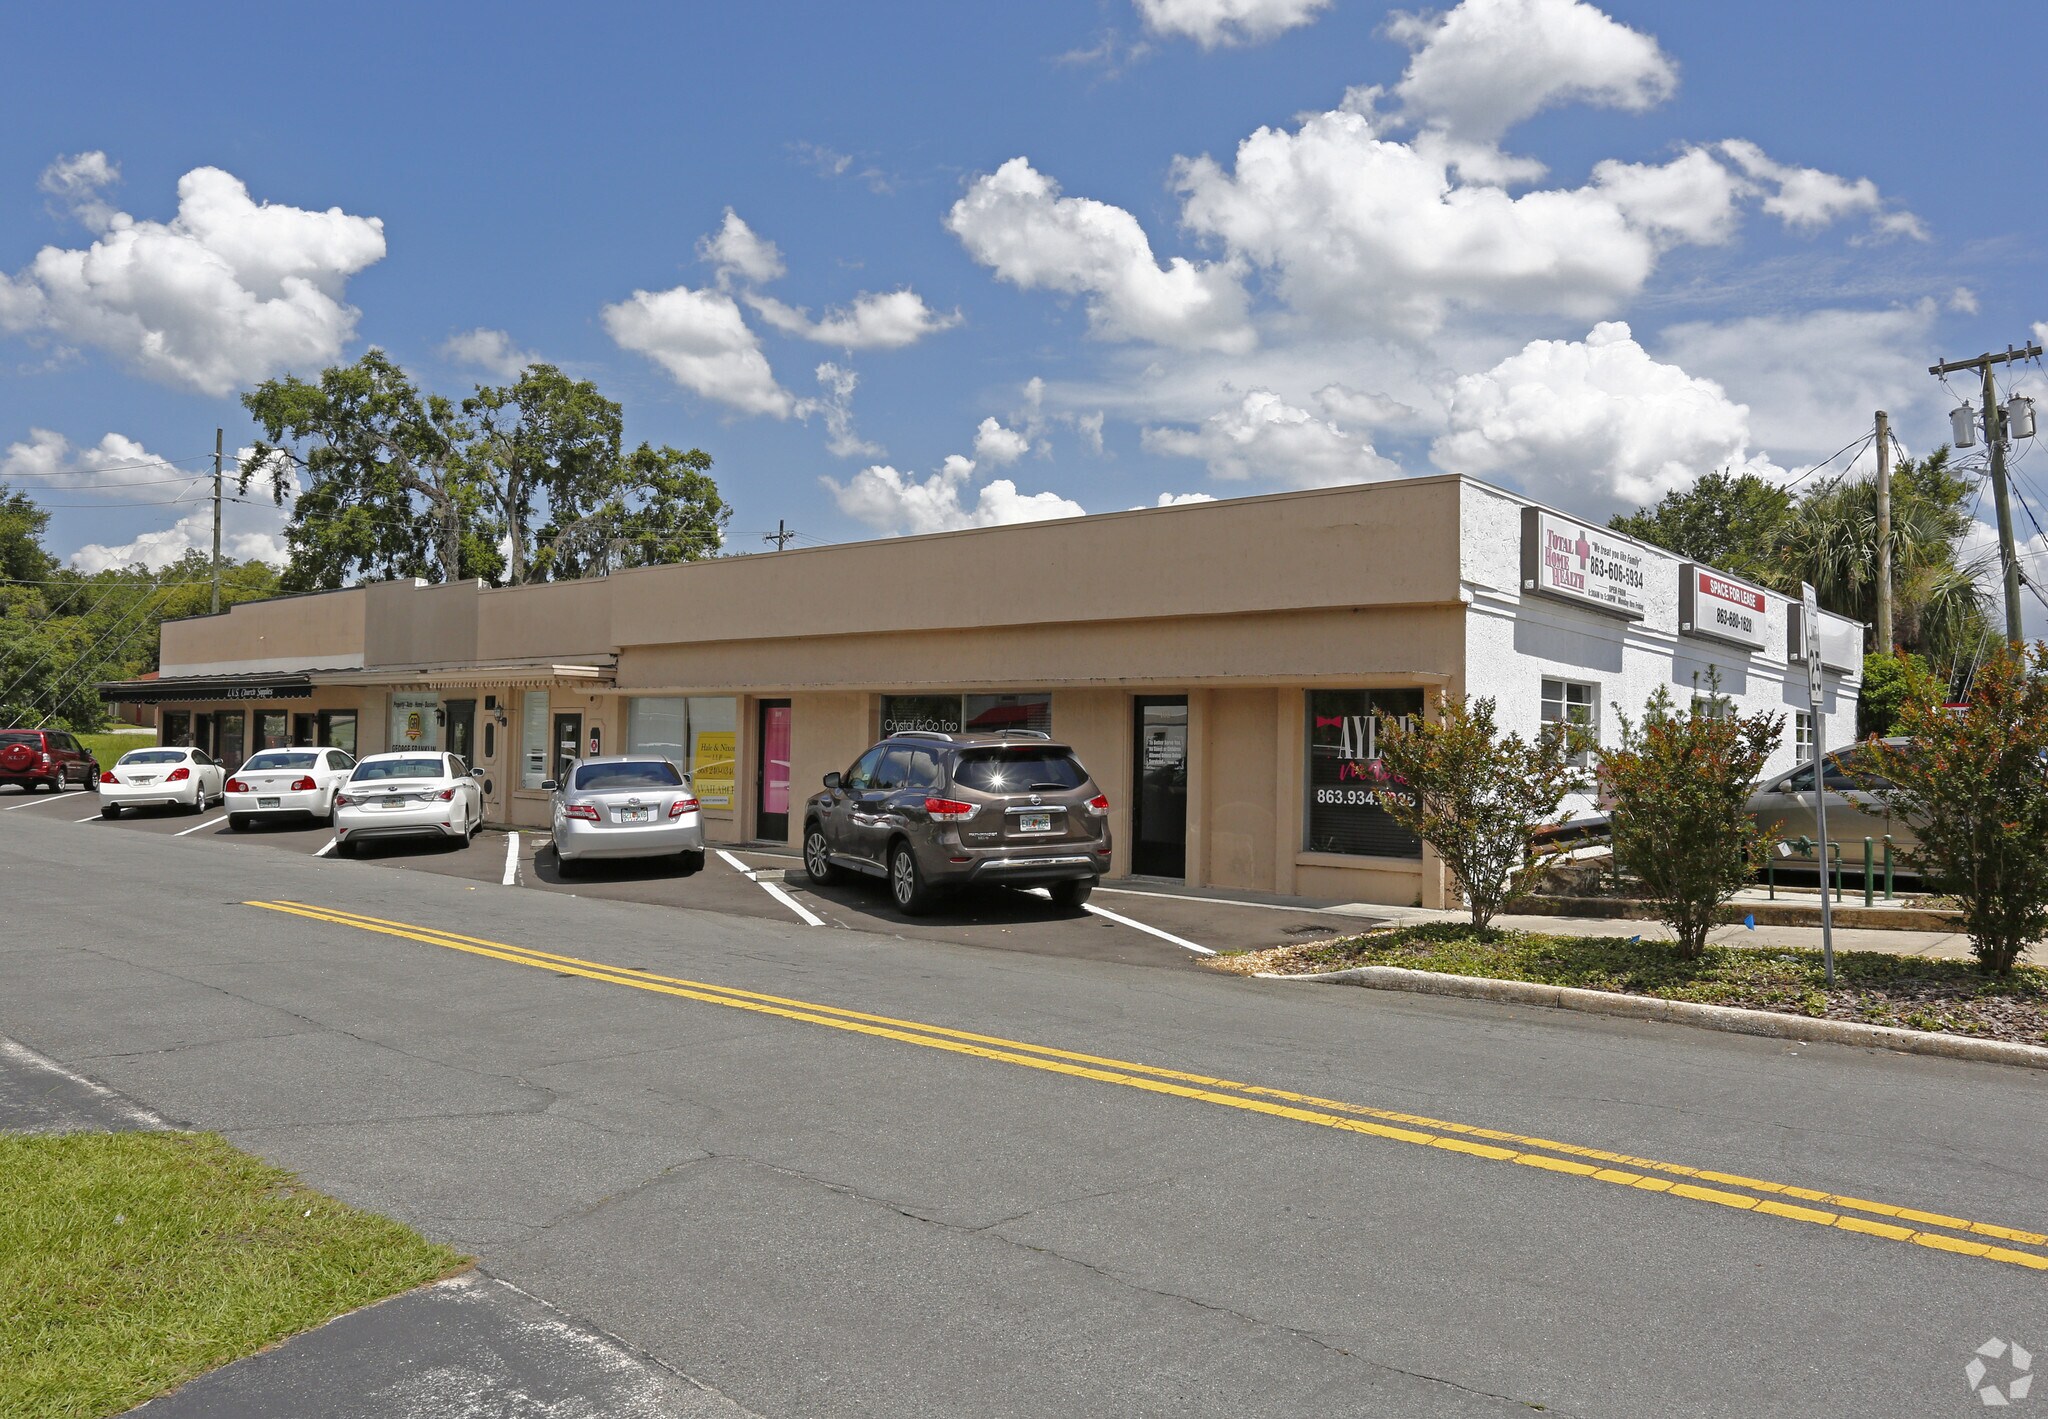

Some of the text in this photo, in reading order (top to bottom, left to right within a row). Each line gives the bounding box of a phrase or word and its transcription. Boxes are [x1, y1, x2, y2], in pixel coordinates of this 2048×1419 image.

[1547, 529, 1574, 554] TOTAL
[1601, 545, 1611, 556] treat
[1545, 545, 1569, 570] HOME
[1552, 567, 1584, 589] HEALTH
[1590, 556, 1643, 589] 863-606-5934
[1609, 585, 1626, 597] OPEN FROM
[1710, 579, 1756, 608] SPACE FOR LEASE
[1809, 649, 1821, 691] 25
[240, 688, 256, 697] Church
[256, 687, 273, 698] Supplies
[884, 718, 914, 732] Crystal
[925, 719, 939, 732] Co
[940, 719, 958, 732] Too
[701, 743, 713, 751] Hale
